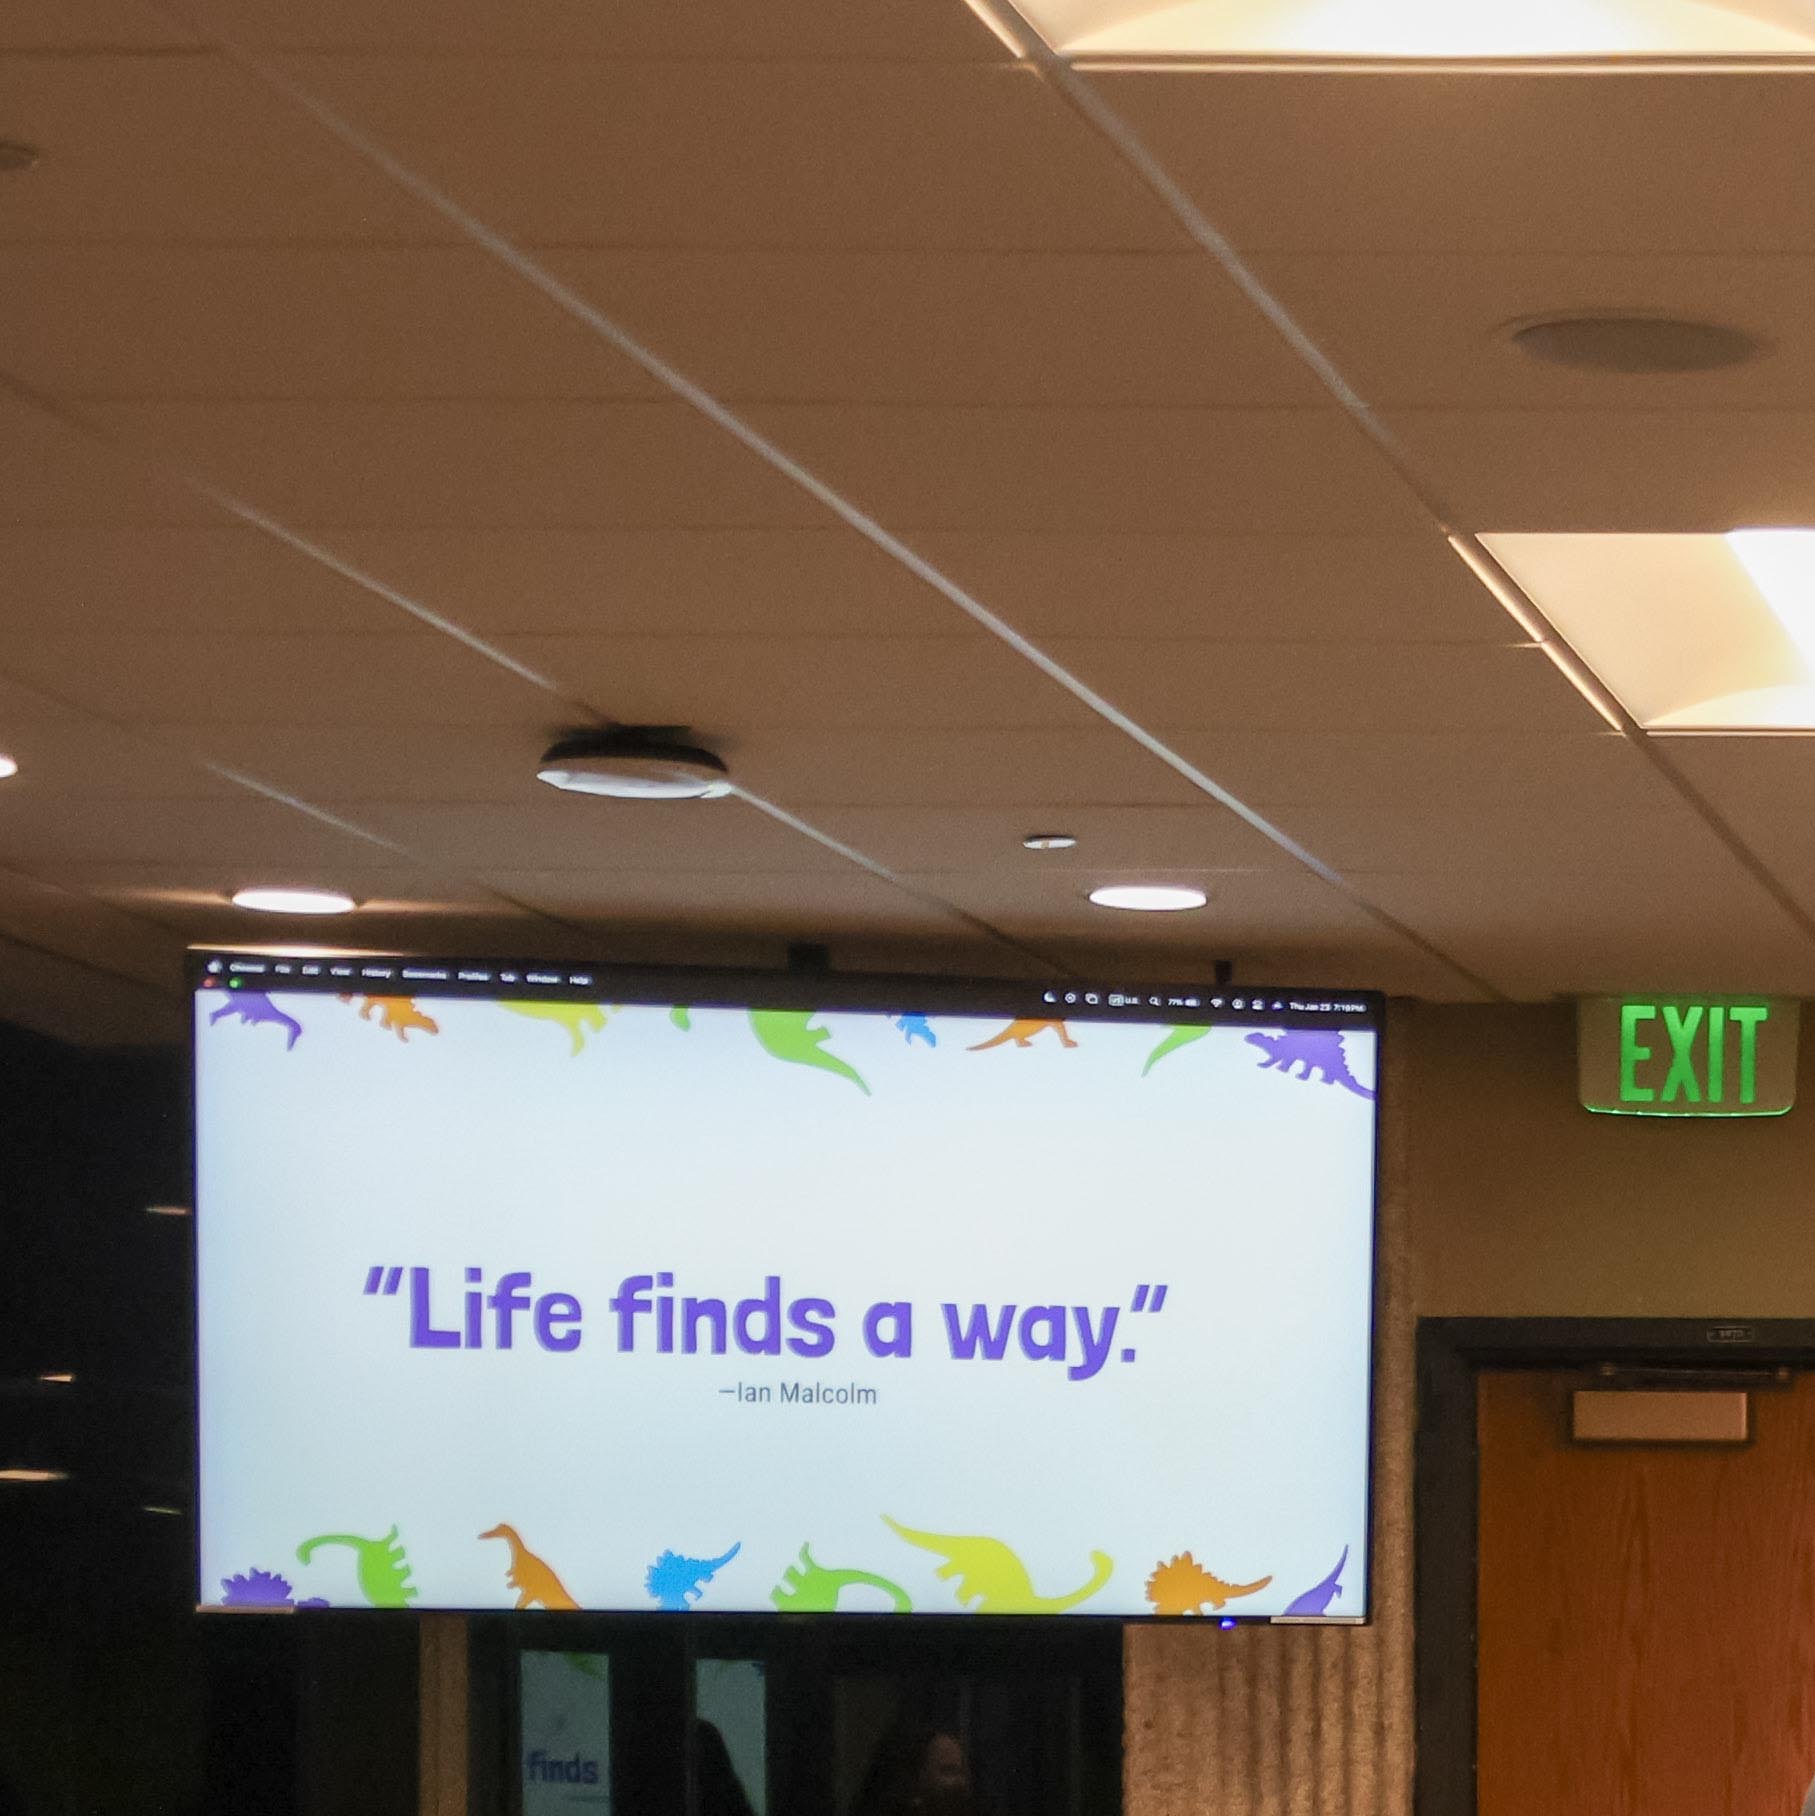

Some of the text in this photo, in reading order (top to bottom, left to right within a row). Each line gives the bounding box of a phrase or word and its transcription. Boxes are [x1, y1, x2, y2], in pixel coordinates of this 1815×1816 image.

[1620, 1005, 1768, 1103] EXIT
[609, 1271, 836, 1358] finds
[863, 1301, 912, 1358] a
[780, 1382, 877, 1404] Malcolm
[527, 1749, 598, 1785] finds
